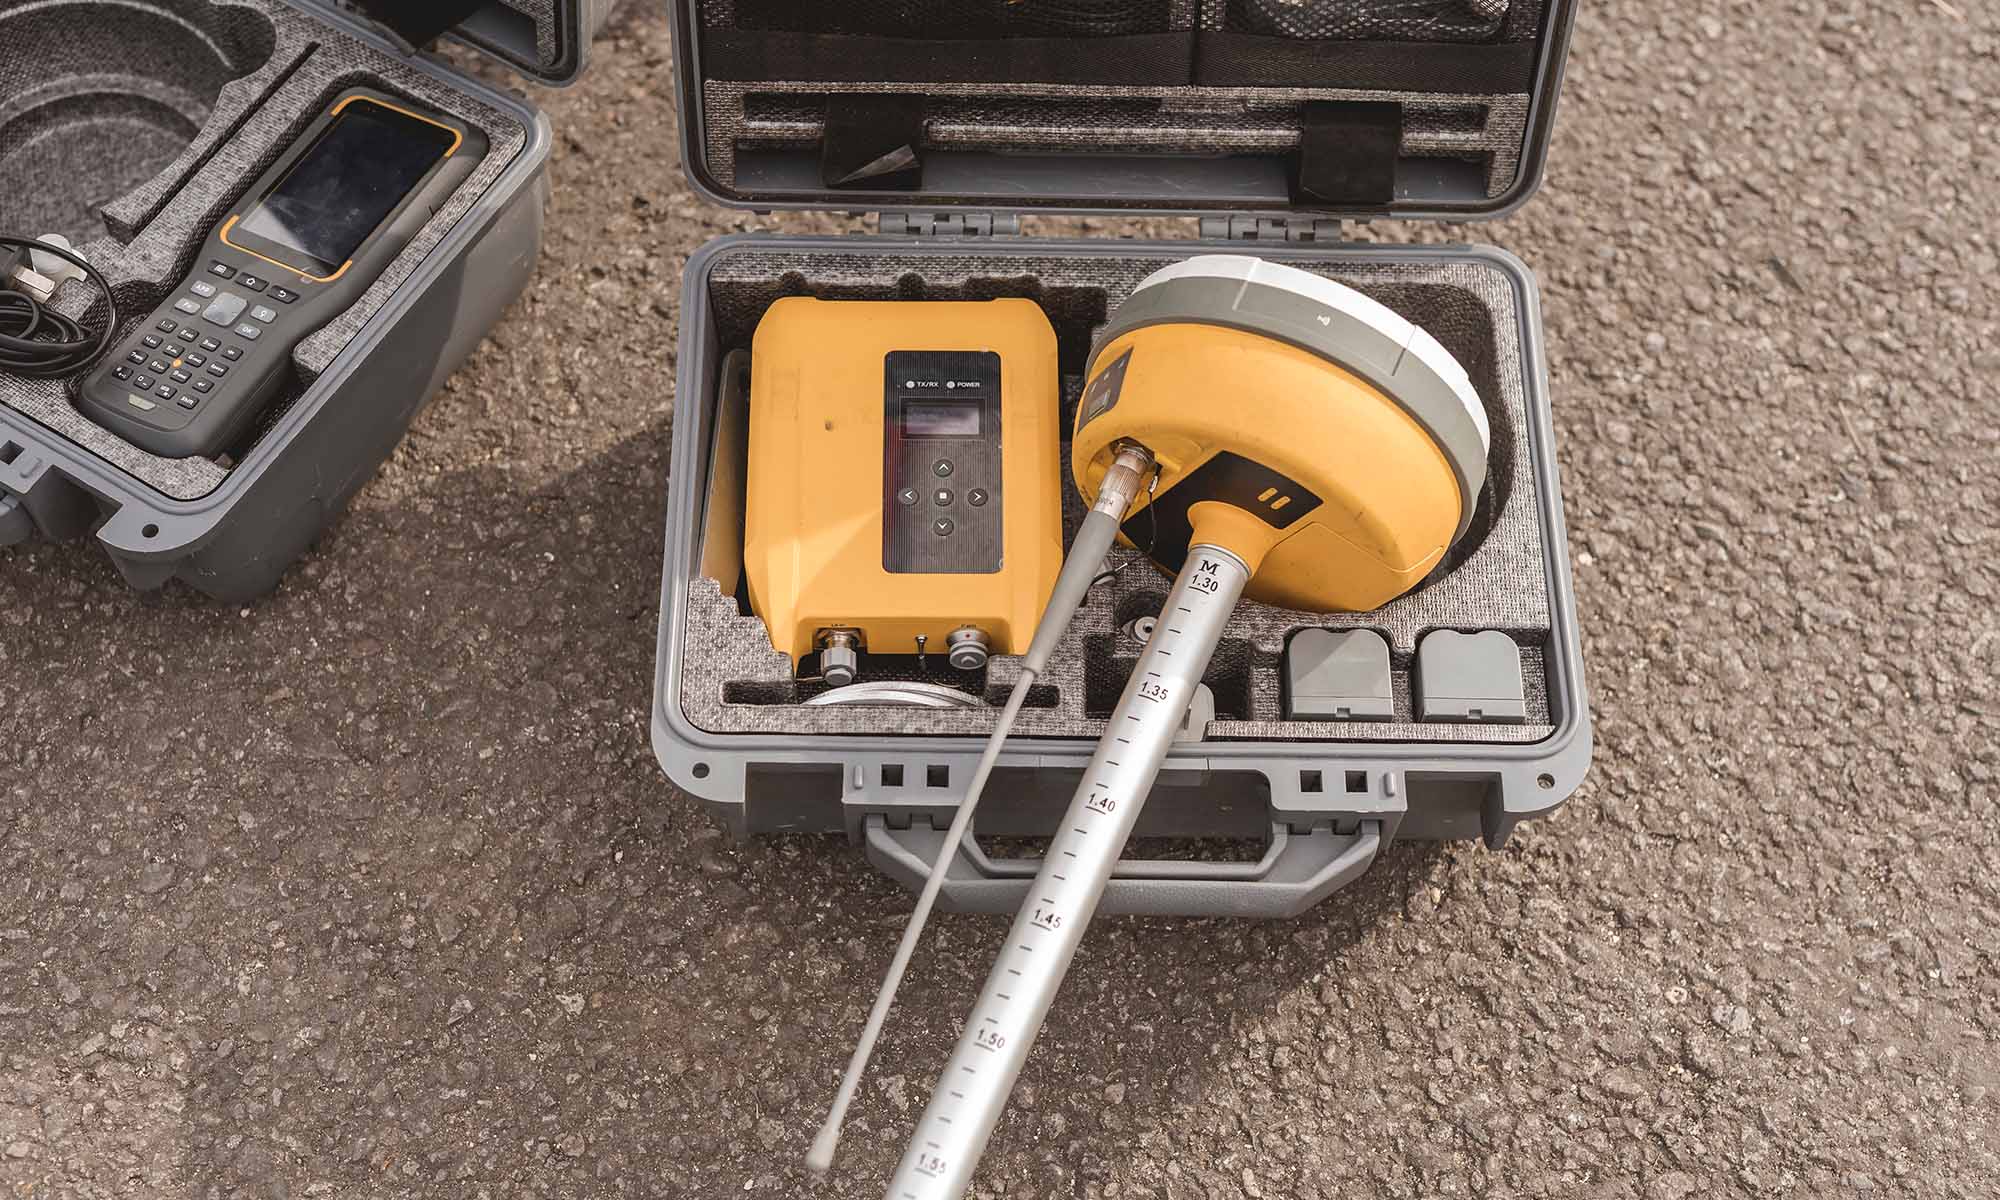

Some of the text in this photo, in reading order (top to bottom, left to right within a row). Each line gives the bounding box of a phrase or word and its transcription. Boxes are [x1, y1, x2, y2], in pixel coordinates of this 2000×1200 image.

[1199, 559, 1220, 577] M
[1192, 574, 1219, 592] 1.30
[1141, 681, 1169, 700] 1.35
[1088, 793, 1115, 812] 1.40
[1034, 909, 1062, 928] 1.45
[977, 1028, 1006, 1049] 1.50
[919, 1153, 947, 1174] 1.55
